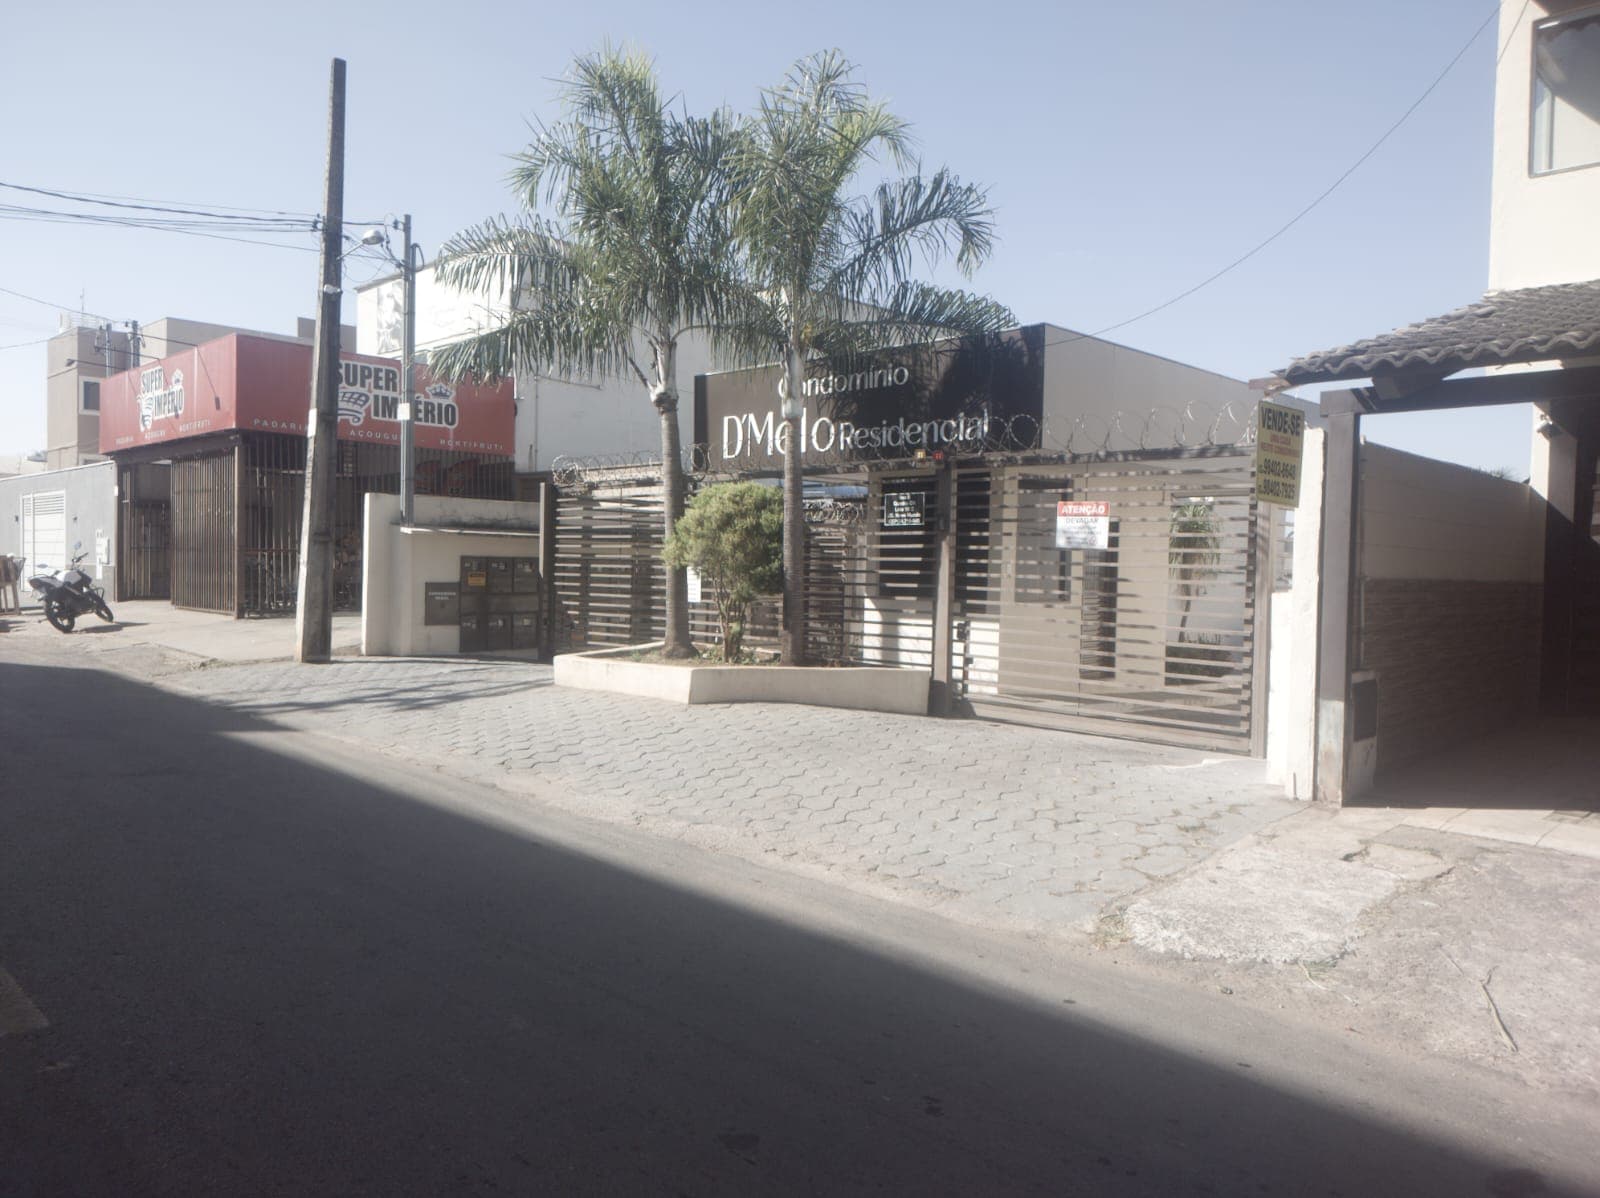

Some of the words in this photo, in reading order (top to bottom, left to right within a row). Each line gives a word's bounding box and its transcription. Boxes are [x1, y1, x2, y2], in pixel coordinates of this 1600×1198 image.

[141, 367, 163, 395] SUPER
[373, 393, 456, 427] IMÉRIO
[1262, 406, 1301, 437] VENDE-SE
[349, 428, 399, 440] AÇOUGU
[440, 438, 504, 450] HORTIFRUTI
[839, 407, 989, 451] Residencial
[1061, 503, 1106, 515] ATENÇÃO
